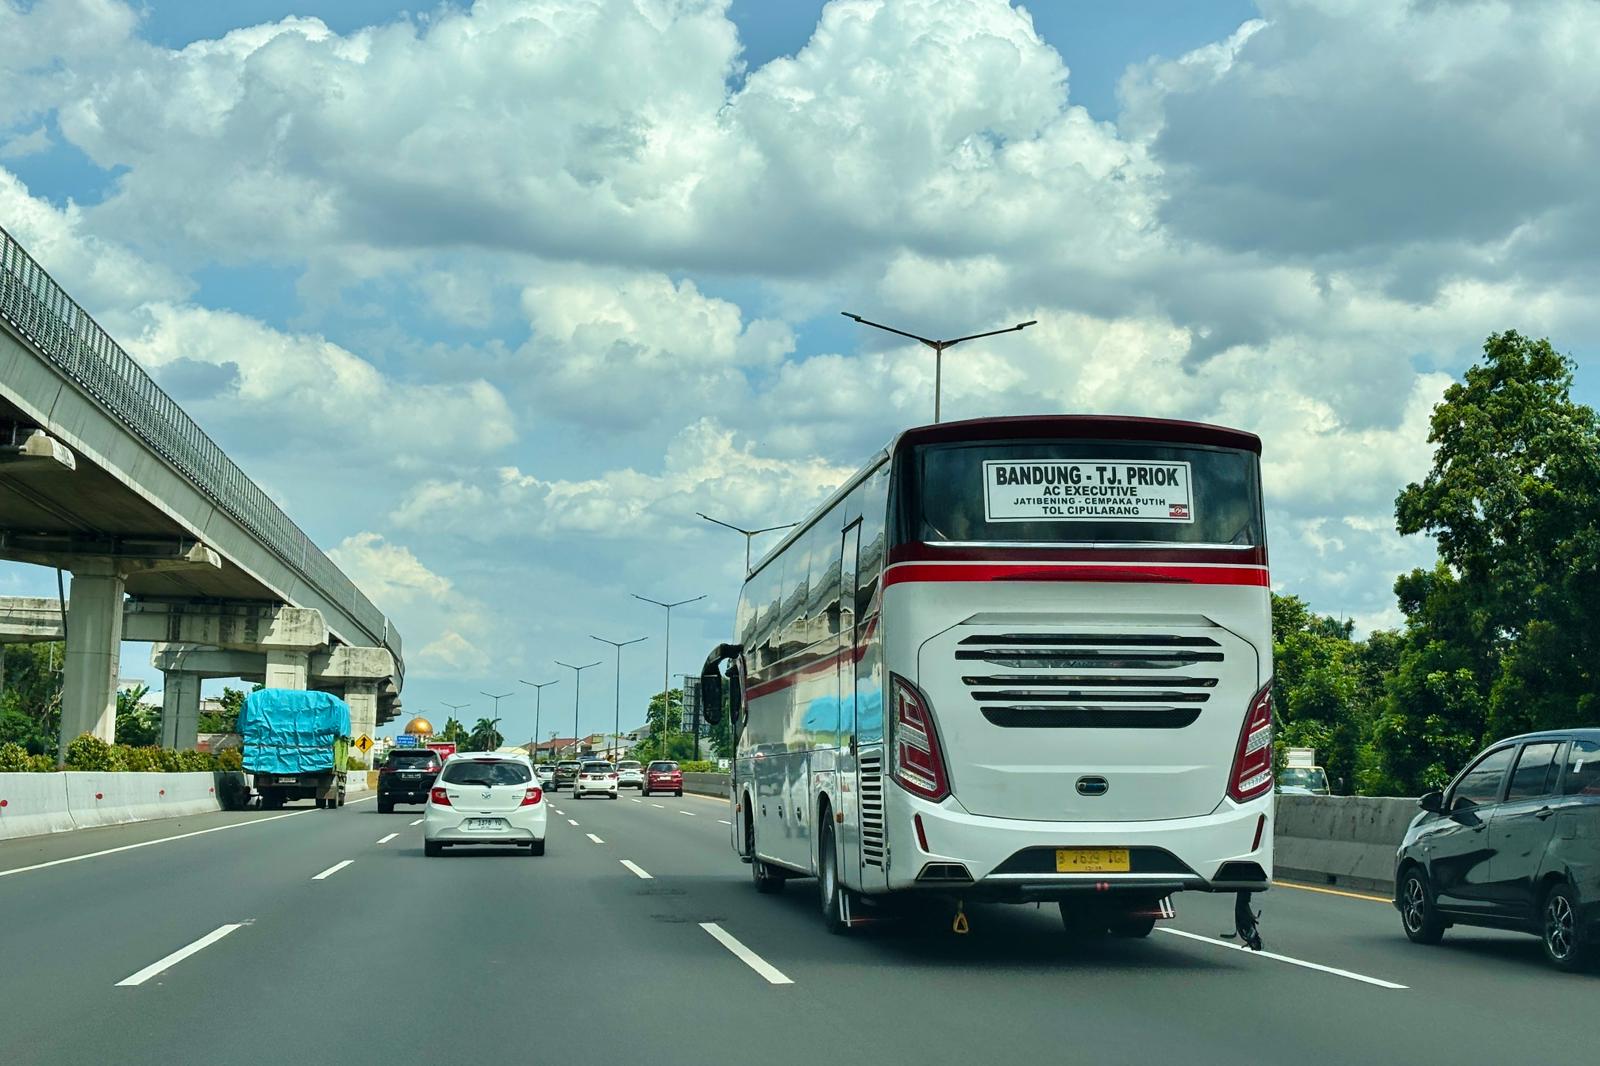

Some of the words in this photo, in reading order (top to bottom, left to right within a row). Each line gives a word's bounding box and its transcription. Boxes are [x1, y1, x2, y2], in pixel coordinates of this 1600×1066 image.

[996, 466, 1081, 485] BANDUNG
[1096, 467, 1122, 485] TJ.
[1127, 467, 1179, 486] PRIOK
[1043, 486, 1060, 496] AC
[1065, 486, 1138, 496] EXECUTIVE
[1013, 497, 1076, 505] JATIBENING
[1135, 498, 1166, 506] PUTIH
[1042, 506, 1063, 515] TOL
[1067, 506, 1140, 515] CIPULARANG
